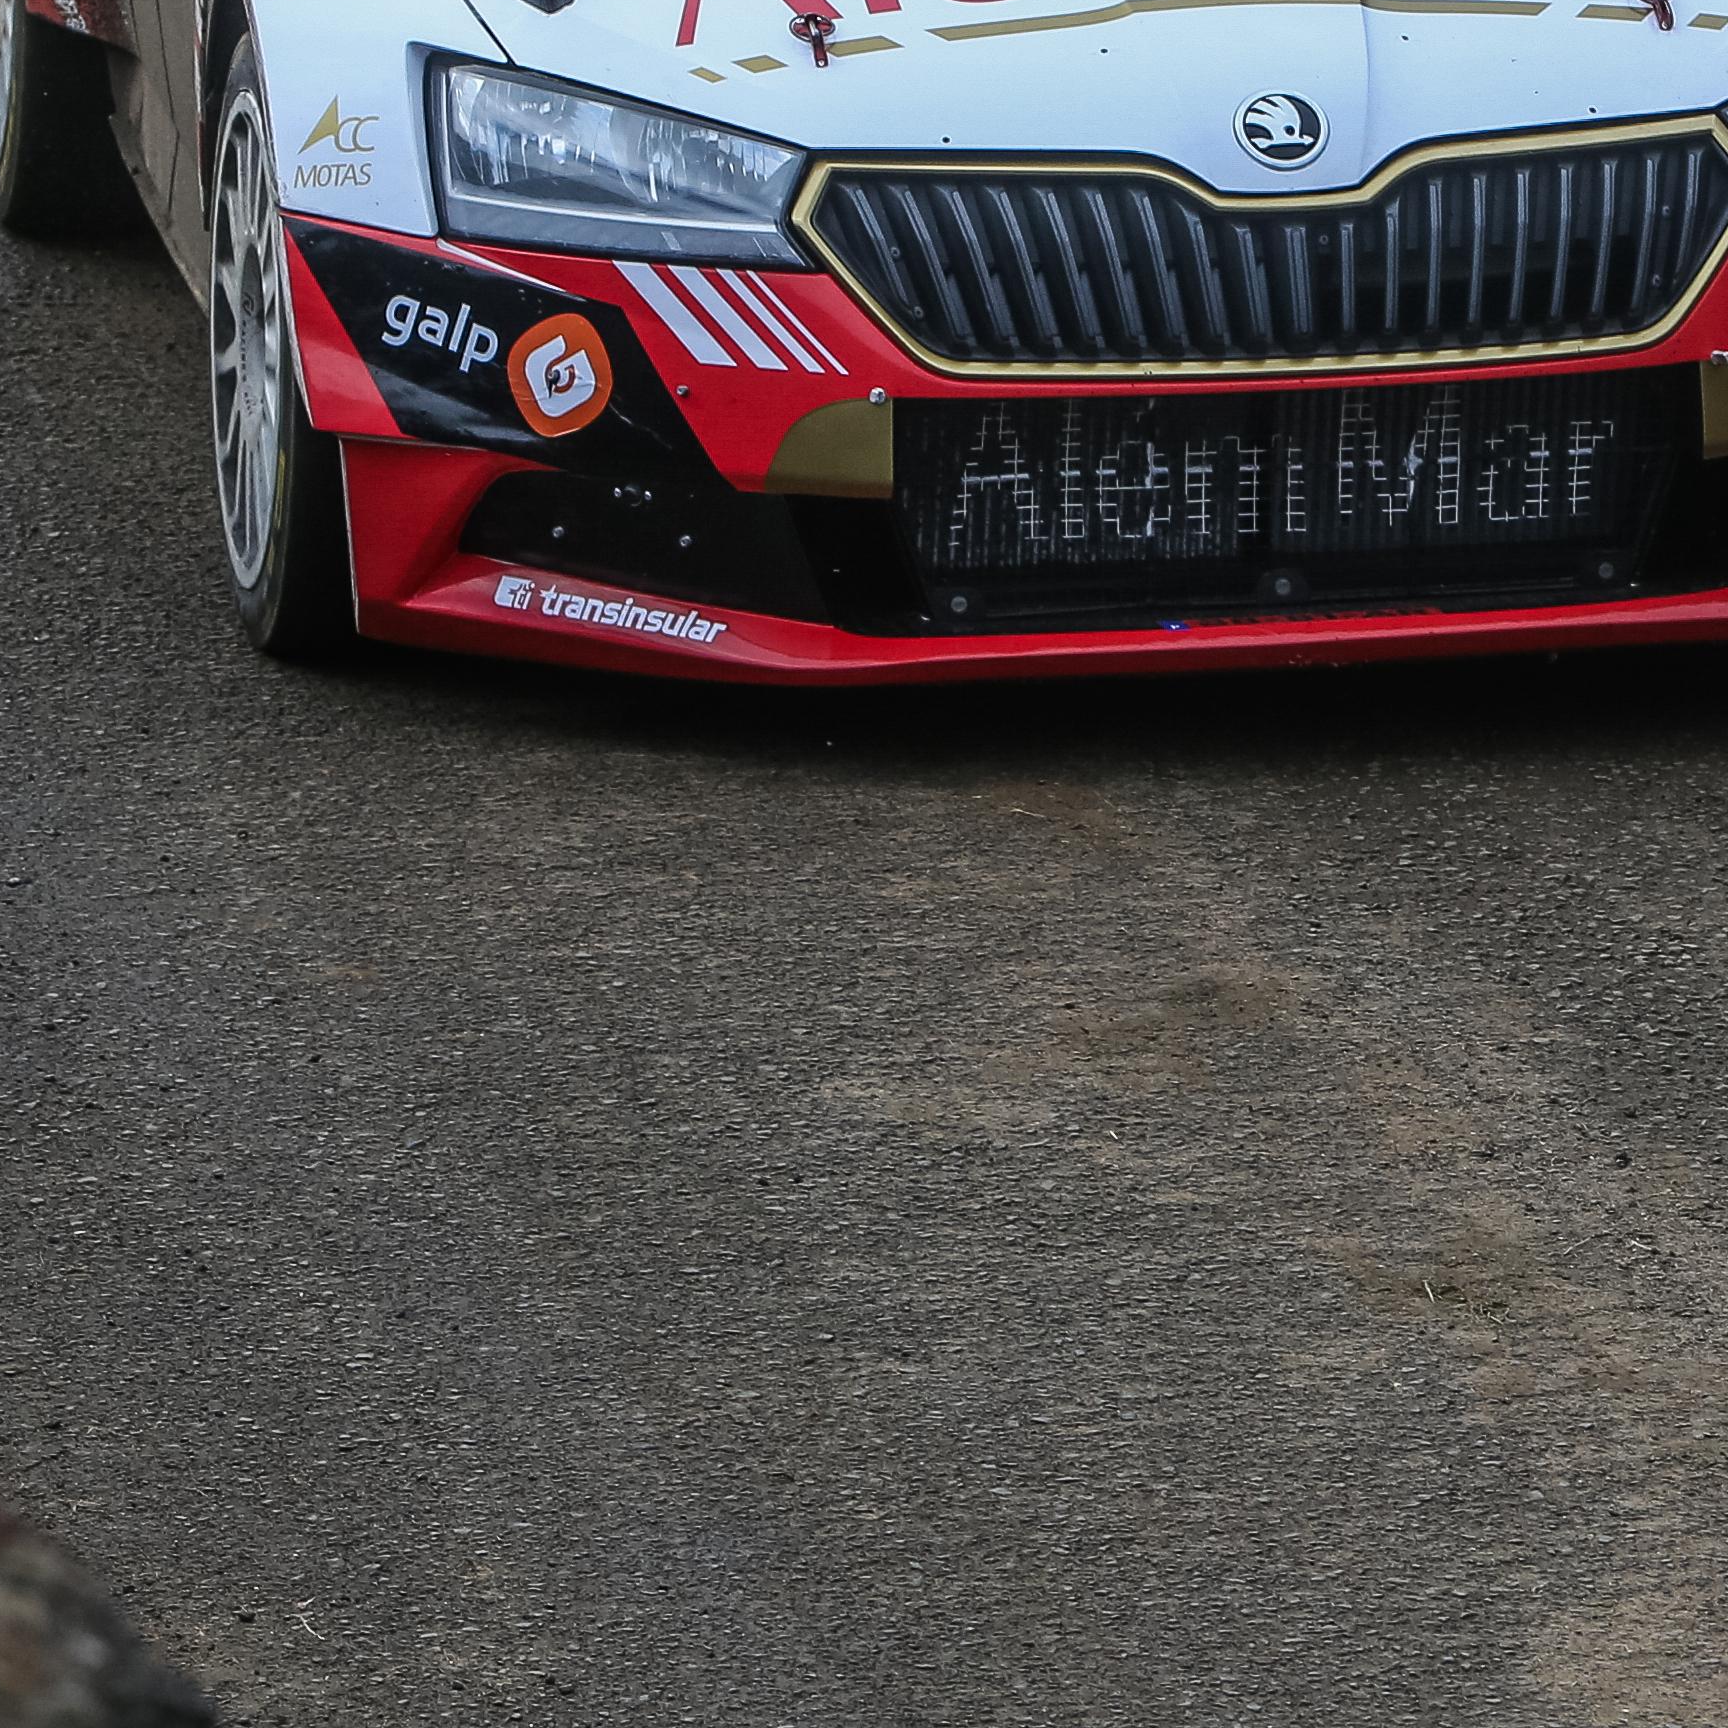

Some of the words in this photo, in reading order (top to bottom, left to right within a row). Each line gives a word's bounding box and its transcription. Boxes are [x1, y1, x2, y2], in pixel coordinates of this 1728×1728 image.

[293, 162, 371, 189] MOTAS
[381, 294, 499, 373] galp
[540, 584, 727, 643] transinsular
